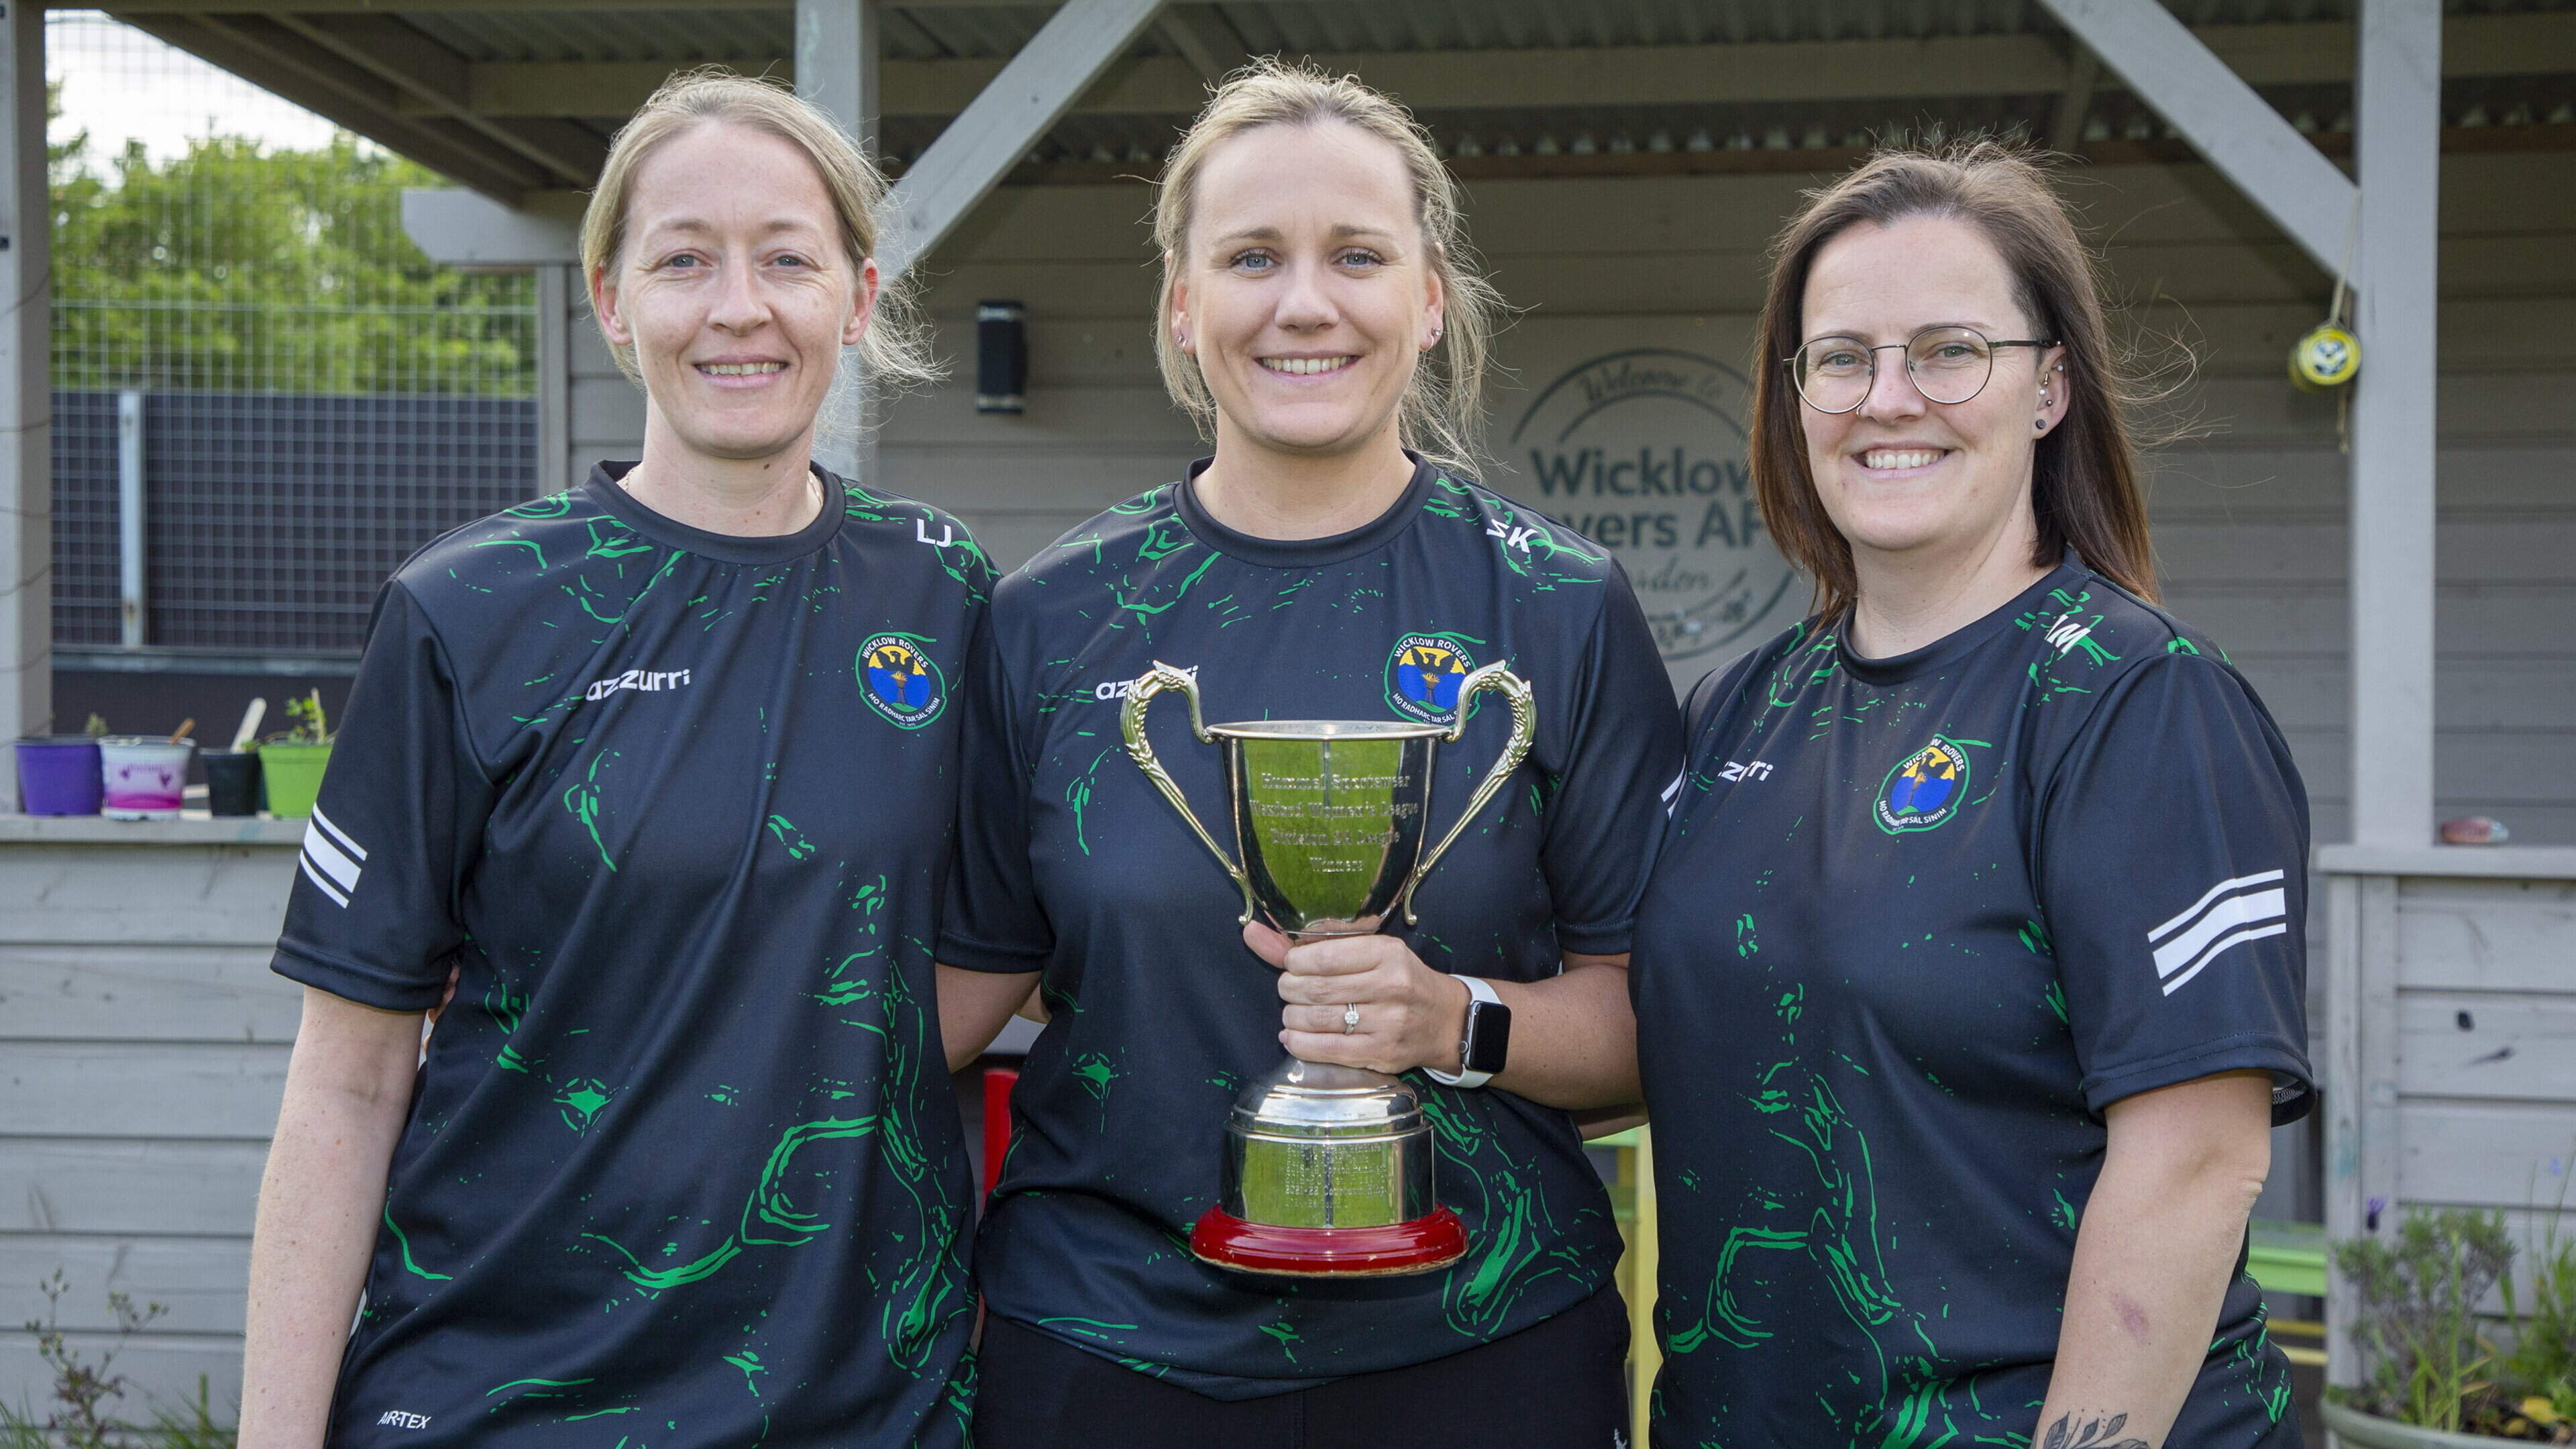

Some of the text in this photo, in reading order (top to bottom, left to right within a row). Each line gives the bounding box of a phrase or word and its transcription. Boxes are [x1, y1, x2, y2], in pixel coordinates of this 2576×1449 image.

[916, 518, 951, 547] LJ
[1486, 519, 1538, 553] SK
[1562, 500, 1766, 548] vers AF
[861, 637, 929, 668] WICKLOW ROVERS
[1394, 637, 1471, 668] WICKLOW ROVERS
[586, 669, 690, 701] azzurri
[868, 693, 880, 704] MO
[1393, 692, 1403, 704] MO
[1401, 702, 1431, 721] RADHARC
[1430, 714, 1443, 724] TAR
[1941, 744, 1965, 772] ROVERS
[376, 1410, 432, 1429] AIR-TEX
